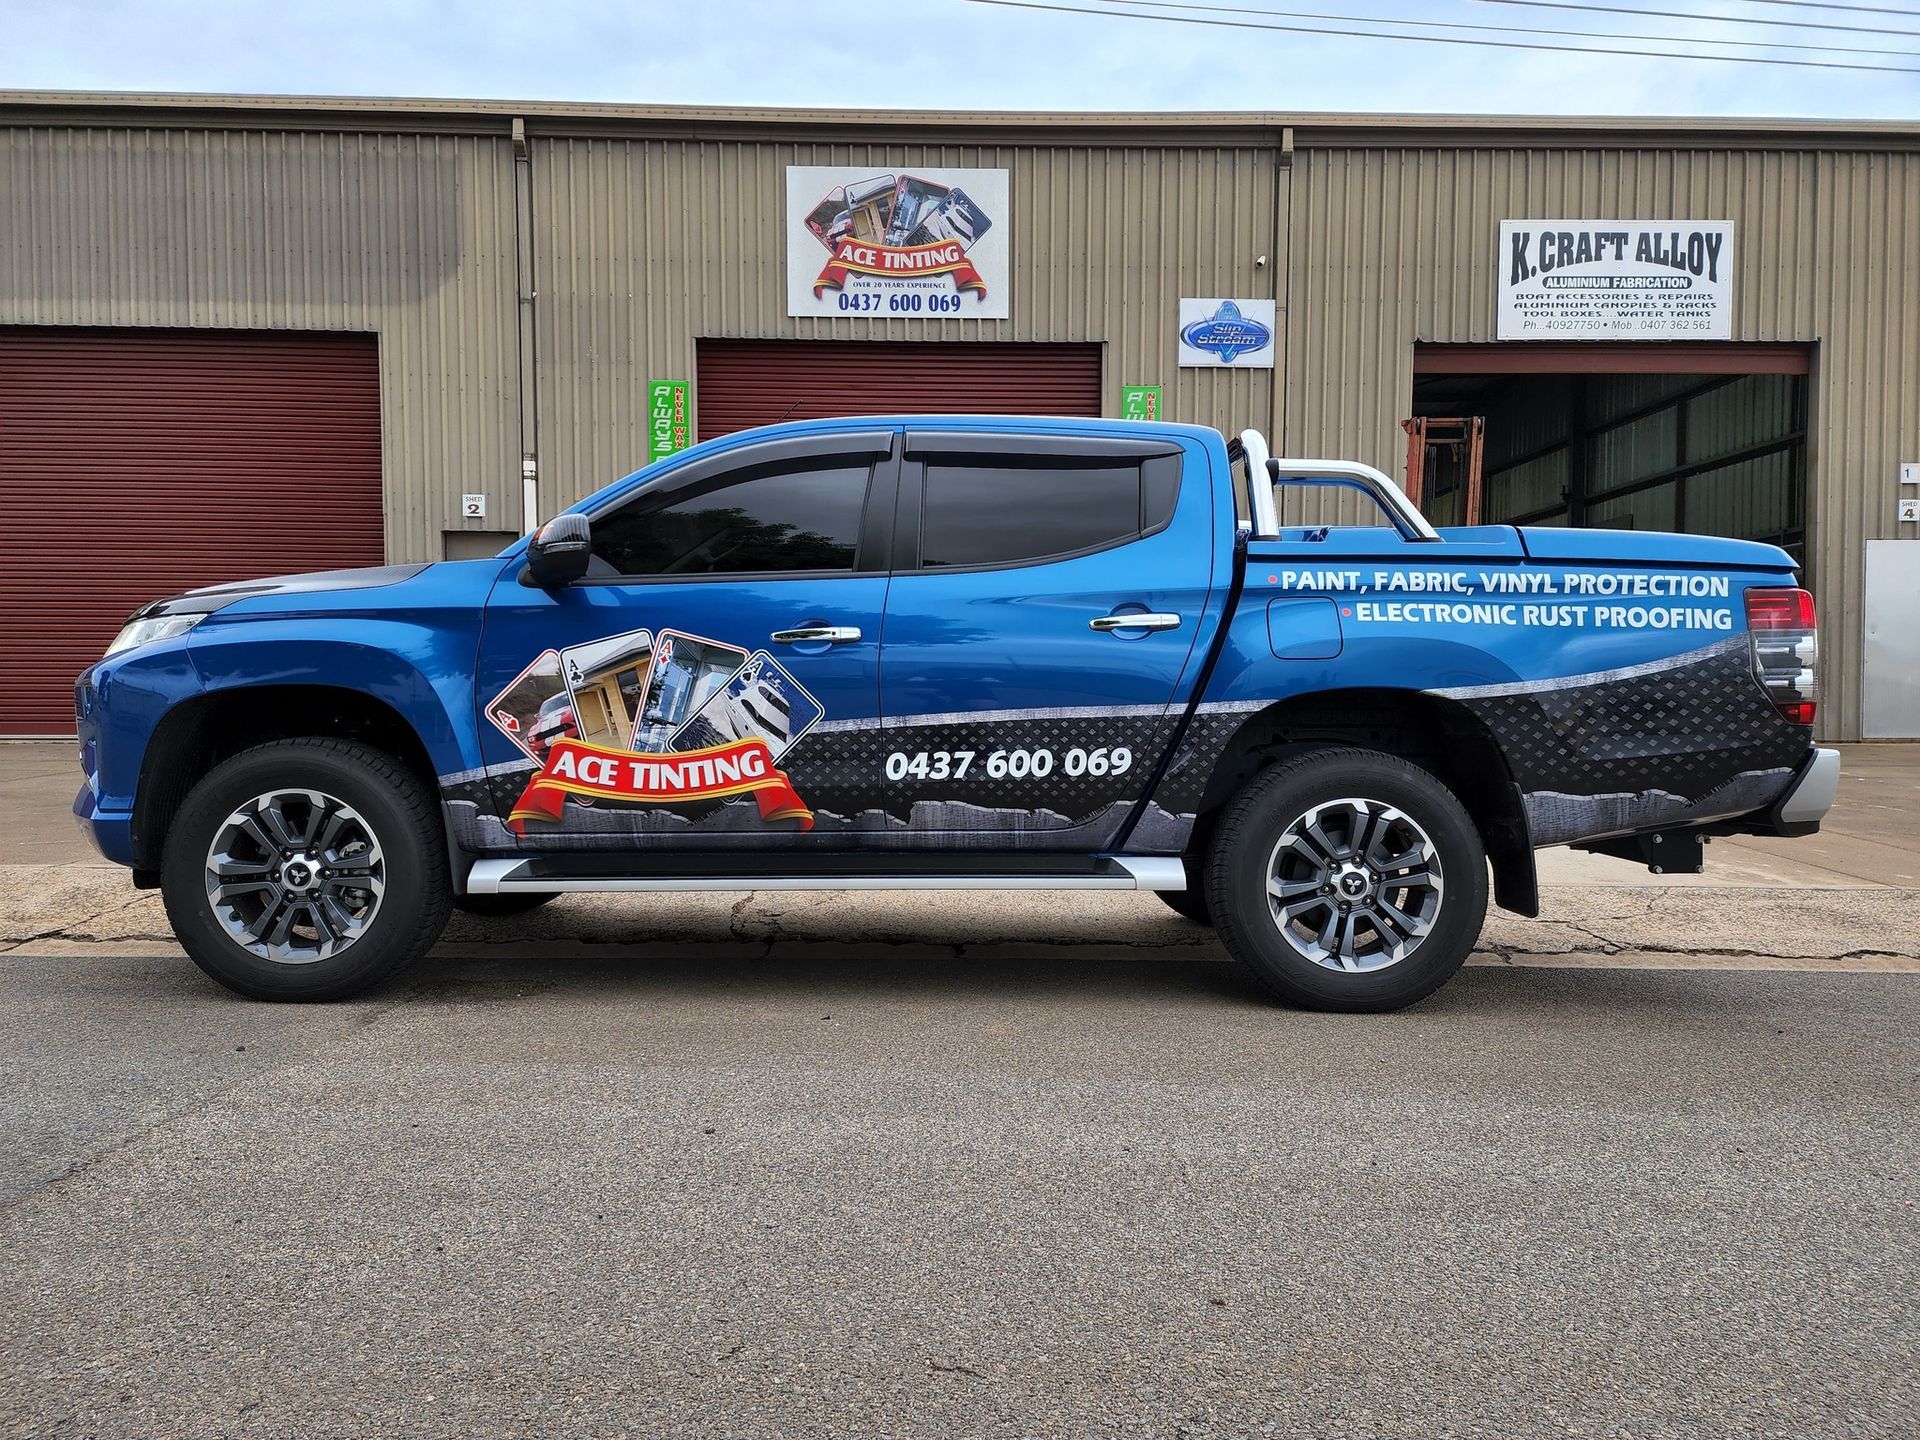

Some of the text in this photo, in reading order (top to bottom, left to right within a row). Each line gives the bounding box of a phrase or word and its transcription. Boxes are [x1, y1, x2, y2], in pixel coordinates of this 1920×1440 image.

[839, 245, 960, 269] ACE TINTING
[1510, 231, 1723, 287] K.CRAFT ALLOY
[852, 281, 947, 290] OVER 20 YEARS EXPERIENCE
[1546, 277, 1688, 289] ALUMINIUM FABRICATION
[838, 293, 961, 312] 0437 600 069
[1659, 293, 1714, 301] REPAIRS
[1669, 310, 1711, 318] TANKS
[1670, 320, 1690, 330] 362
[1692, 320, 1712, 330] 561
[652, 385, 673, 452] ALWAYS
[673, 386, 687, 449] NEVER WAX
[1904, 468, 1910, 478] 1
[467, 504, 480, 514] 2
[1903, 508, 1915, 519] 4
[1282, 571, 1729, 597] PAINT, FABRIC, VINYL PROTECTION
[1356, 603, 1732, 630] ELECTRONIC RUST PROOFING
[662, 640, 672, 655] A
[569, 659, 579, 672] A
[551, 749, 766, 791] ACE TINTING
[885, 747, 1132, 781] 0437 600 069
